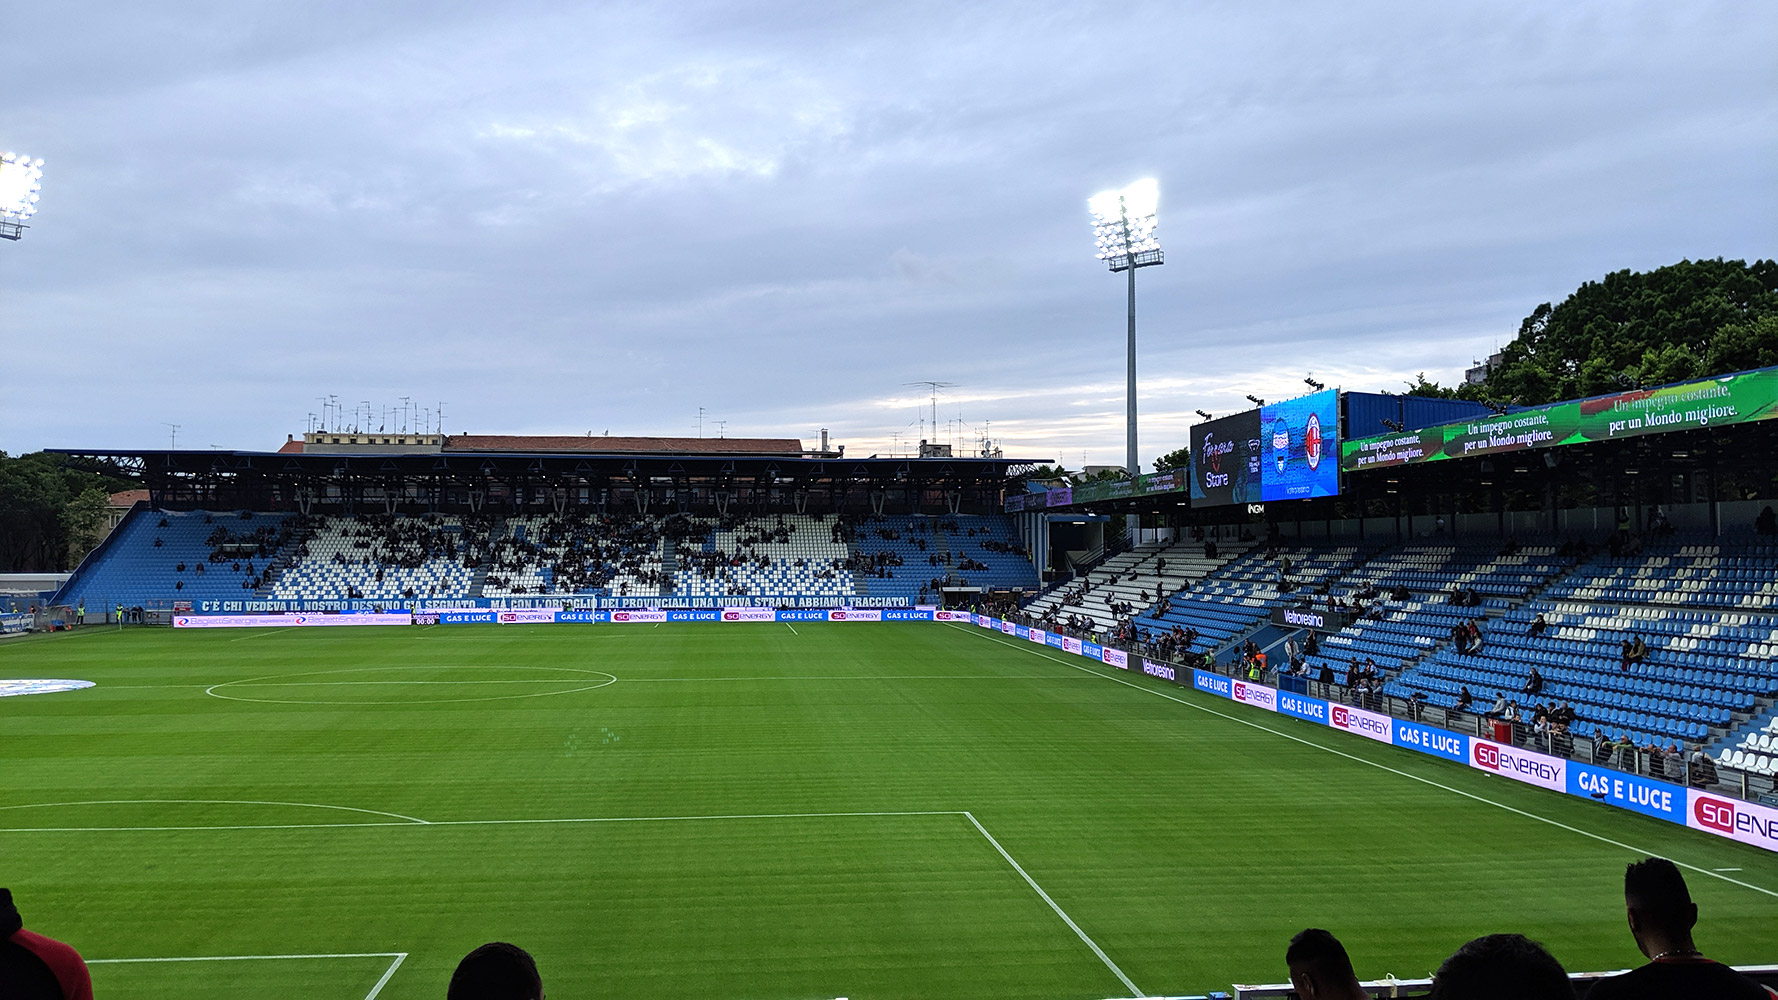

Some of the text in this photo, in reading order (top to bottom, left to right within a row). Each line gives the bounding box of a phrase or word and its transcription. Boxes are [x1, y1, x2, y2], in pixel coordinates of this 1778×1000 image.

[1614, 385, 1731, 412] Un impegno costante,
[1467, 414, 1549, 435] Un impegno costante,
[1609, 404, 1738, 436] per un Mondo migliore.
[1360, 442, 1368, 451] Un
[1369, 438, 1394, 452] impegno
[1464, 429, 1553, 454] per un Mondo migliore.
[1357, 457, 1367, 468] per
[1376, 450, 1396, 462] Mondo
[1206, 472, 1229, 488] Store
[202, 599, 220, 611] C'È
[223, 601, 242, 611] CHI
[245, 601, 287, 611] VEDEVA
[290, 601, 301, 611] IL
[304, 600, 349, 611] NOSTRO
[352, 600, 401, 611] DESTINO
[491, 599, 505, 608] MA
[511, 599, 533, 608] CON
[601, 599, 621, 608] DEI
[623, 598, 690, 608] PROVINCIALI
[692, 598, 717, 608] UNA
[720, 598, 751, 608] NUOVA
[754, 597, 796, 607] STRADA
[798, 597, 846, 607] ABBIAMO
[849, 597, 910, 607] TRACCIATO!
[1283, 609, 1323, 627] Vetroresina
[1142, 658, 1175, 681] Vetroresina
[1197, 675, 1228, 693] GAS E LUCE
[1281, 697, 1324, 718] GAS E LUCE
[1399, 726, 1460, 756] GAS E LUCE
[1578, 771, 1672, 812] GAS E LUCE
